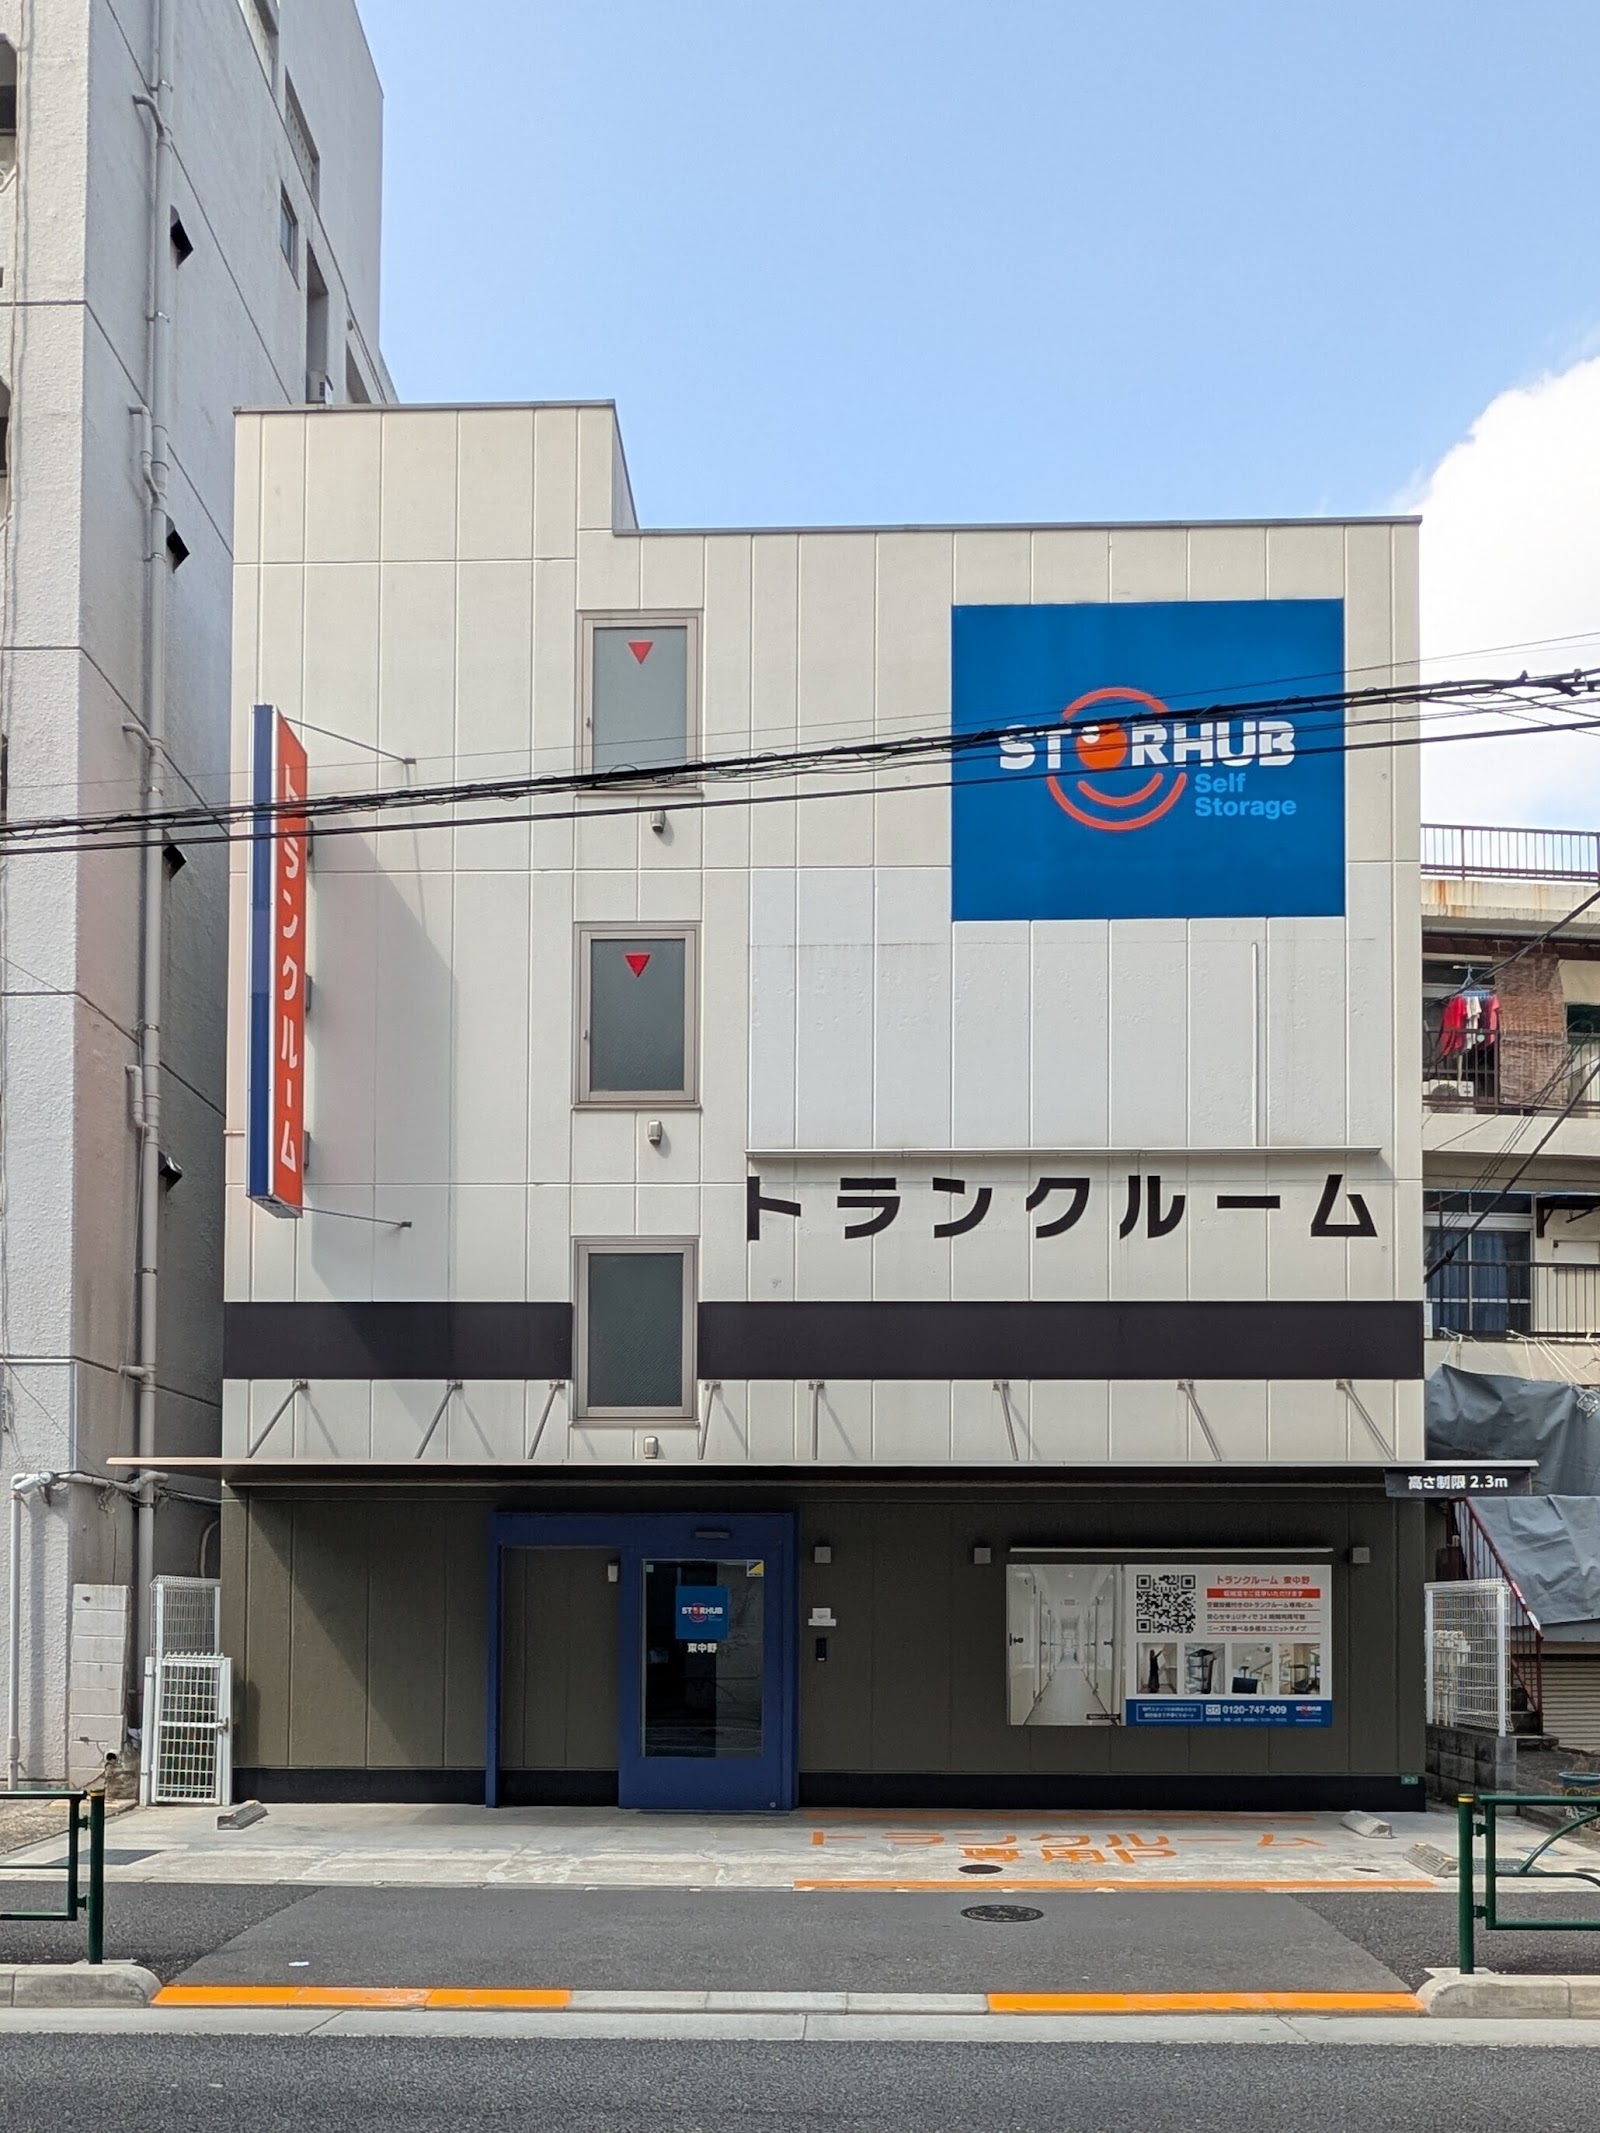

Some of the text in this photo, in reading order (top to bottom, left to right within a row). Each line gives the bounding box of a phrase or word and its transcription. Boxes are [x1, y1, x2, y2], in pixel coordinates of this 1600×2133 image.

[1195, 773, 1246, 793] Self
[1195, 797, 1297, 819] Storage
[280, 763, 299, 1173] トランクルーム
[746, 1173, 1379, 1241] トランクルーム
[1408, 1475, 1508, 1490] 高さ制限 2.3m
[1216, 1575, 1279, 1585] トランクルーム
[687, 1643, 718, 1653] 東中野
[1222, 1705, 1287, 1715] 0120-747-909
[811, 1831, 1328, 1849] トランクルーム
